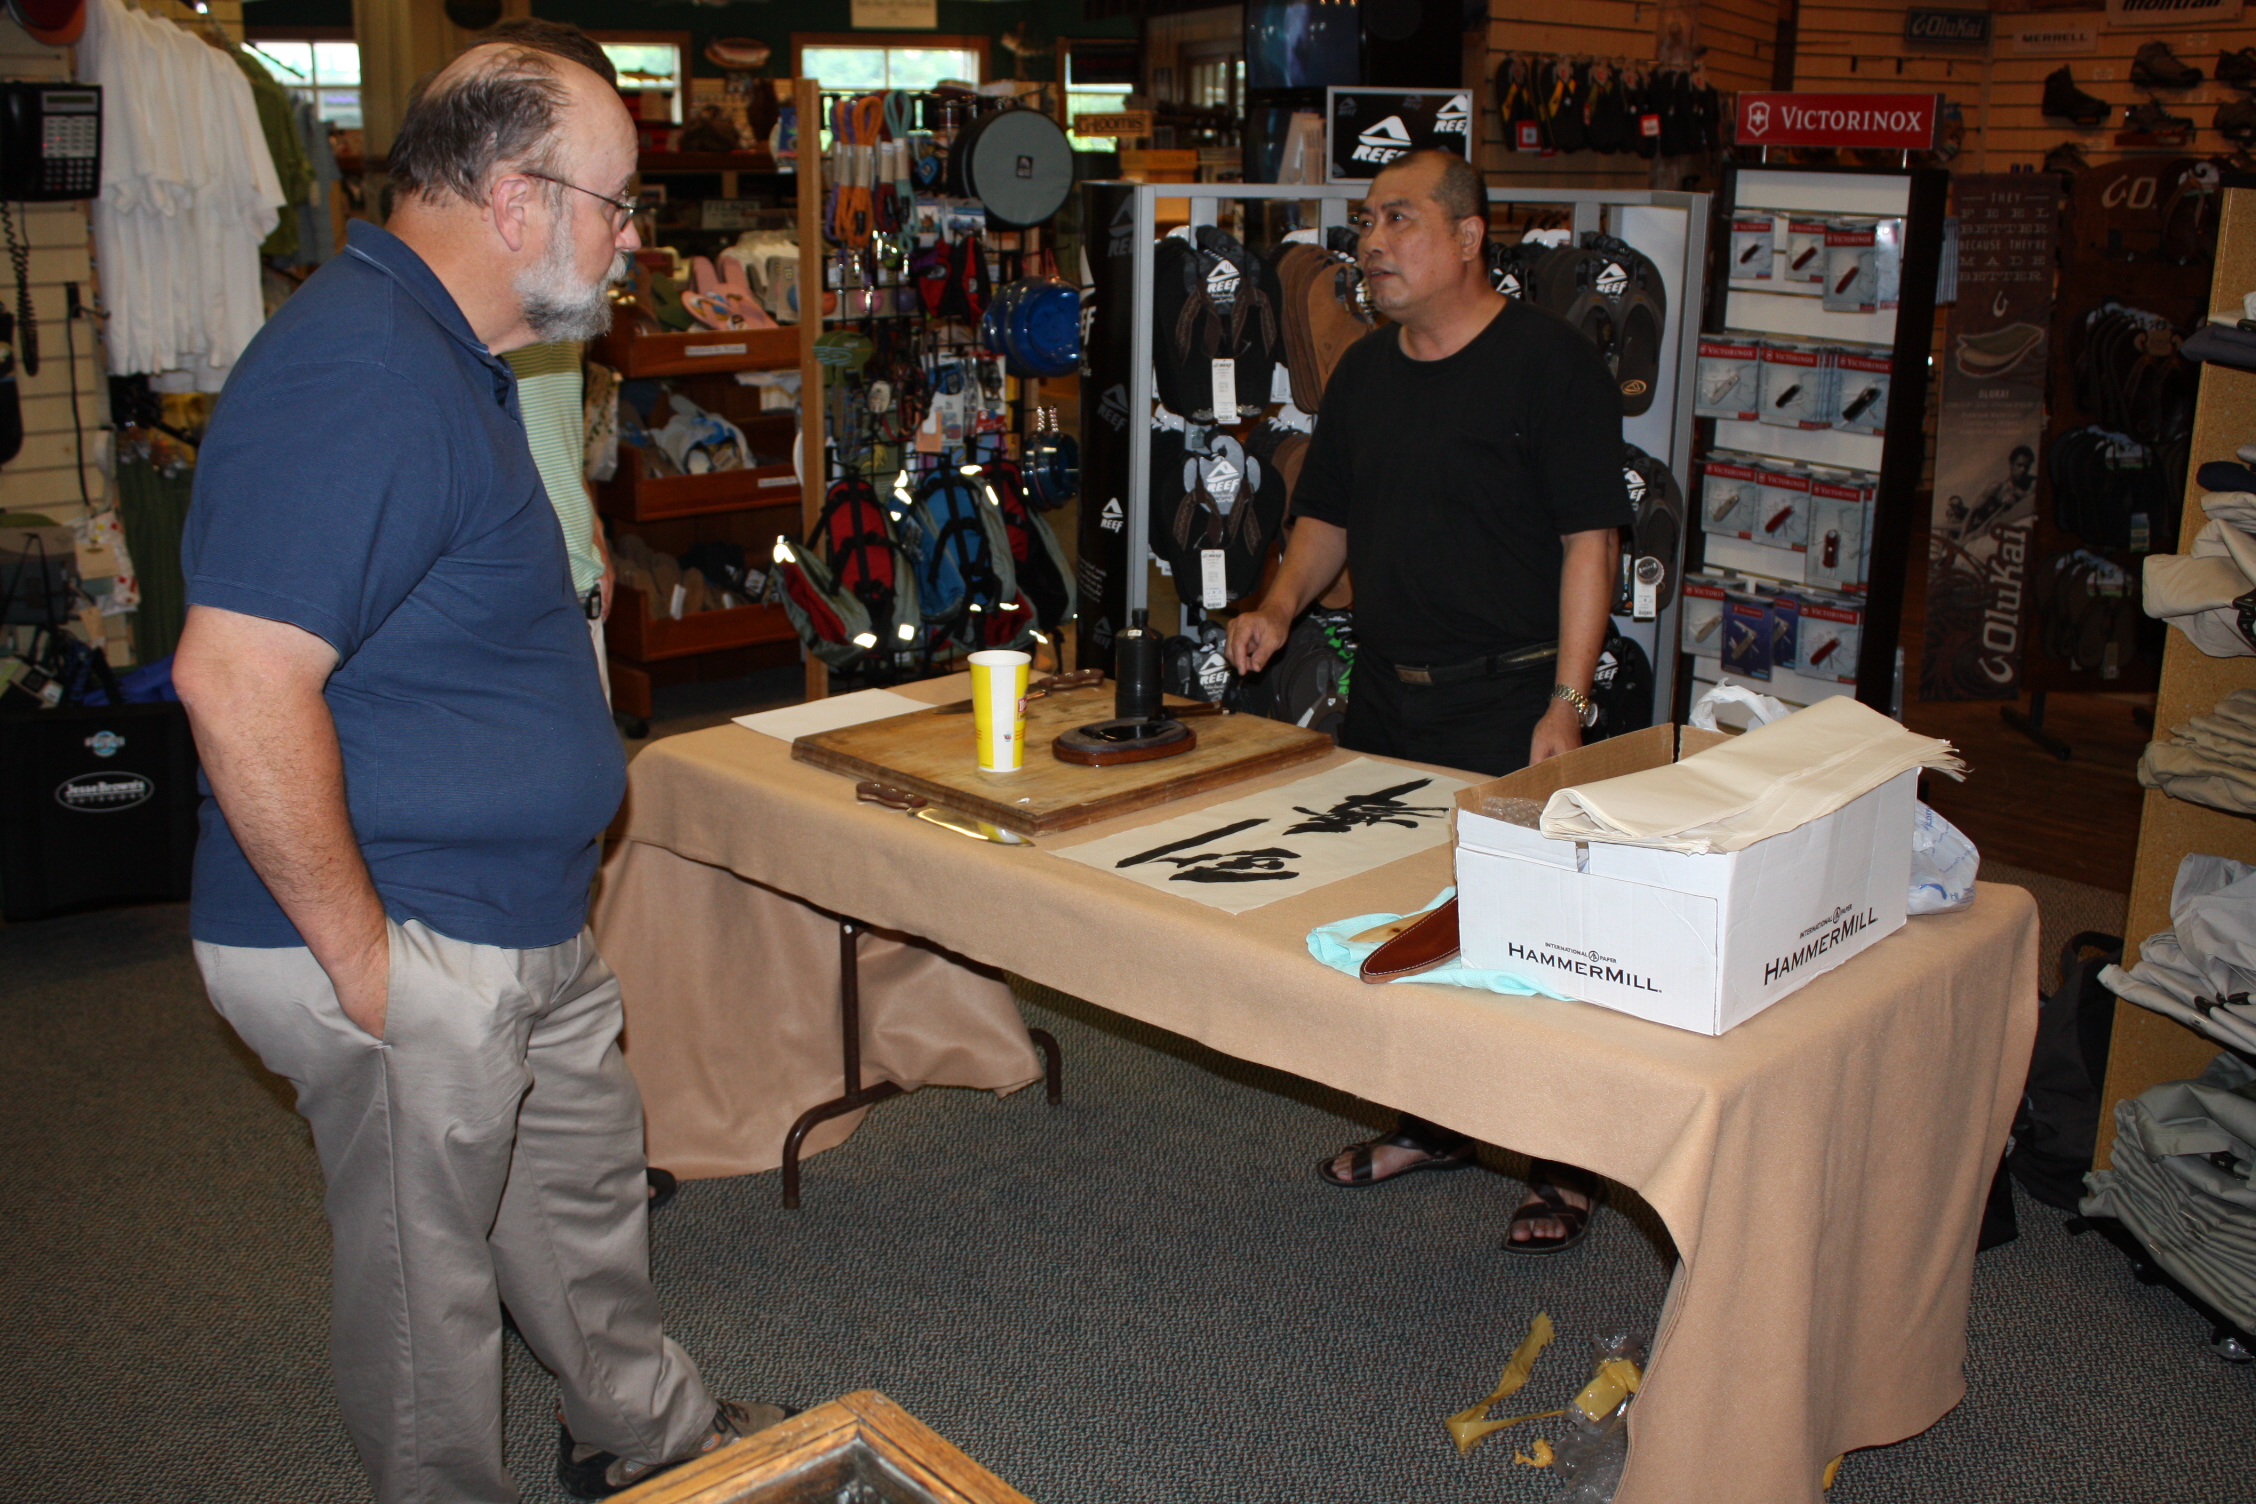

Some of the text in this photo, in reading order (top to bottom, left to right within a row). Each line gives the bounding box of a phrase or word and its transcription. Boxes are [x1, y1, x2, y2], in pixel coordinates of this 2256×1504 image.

[2022, 32, 2088, 42] MERRELL
[1781, 106, 1922, 132] VICTORINOX
[1991, 192, 2021, 204] THEY
[1960, 223, 2048, 234] BETTER
[1833, 233, 1872, 244] VICTORINOX
[1960, 256, 2046, 267] MADE
[1207, 277, 1241, 293] REEF
[1596, 281, 1628, 294] REEF
[1708, 346, 1753, 358] VICTORINOX
[1775, 352, 1814, 364] VICTORINOX
[1850, 358, 1890, 371] VICTORINOX
[1097, 402, 1128, 432] REEF
[1714, 466, 1752, 478] VICTORINOX
[1207, 478, 1241, 493] REEF
[1767, 475, 1807, 489] VICTORINOX
[1820, 487, 1858, 500] VICTORINOX
[1101, 518, 1124, 534] REEF
[1694, 586, 1725, 598] VICTORIN
[1811, 608, 1854, 622] VICTORINOX
[1200, 671, 1230, 686] REEF
[1799, 903, 1852, 939] INTERNATIONAL PAPER
[1545, 941, 1617, 964] INTERNATIONAL PAPER
[1763, 907, 1877, 986] HAMMERMILL
[1508, 942, 1659, 993] HAMMERMILL
